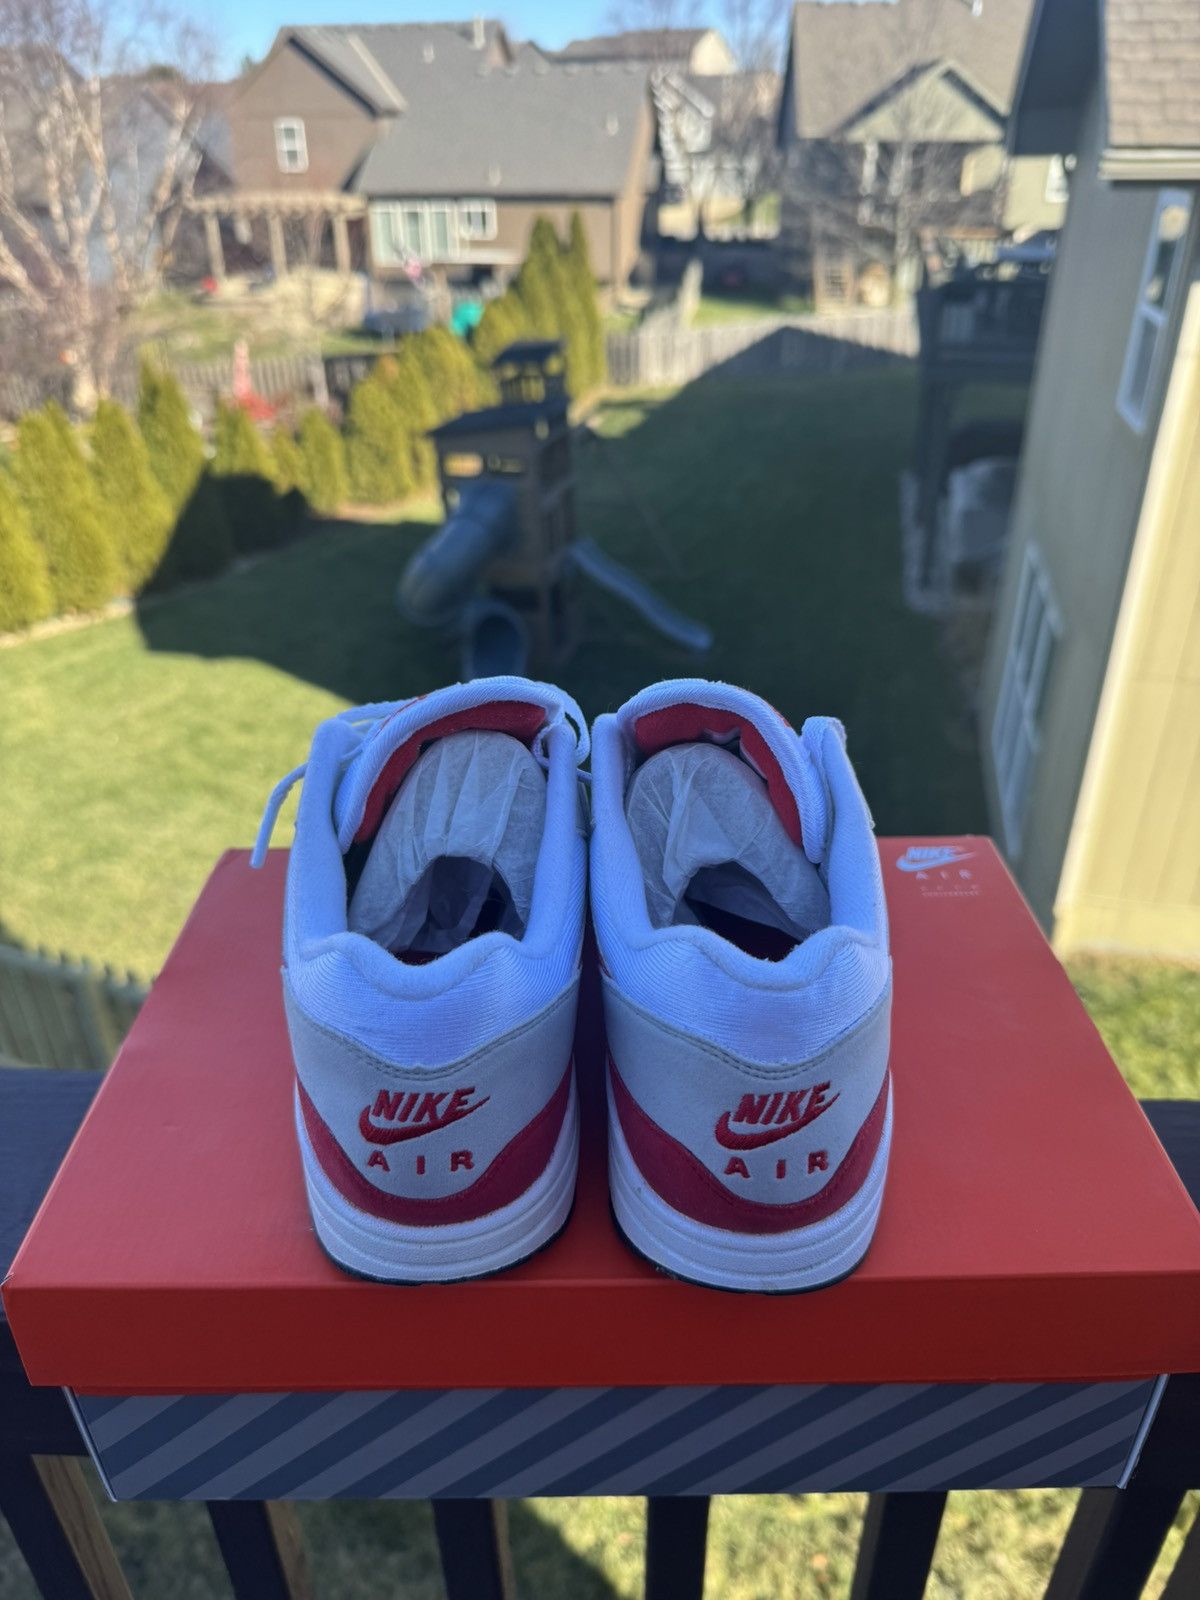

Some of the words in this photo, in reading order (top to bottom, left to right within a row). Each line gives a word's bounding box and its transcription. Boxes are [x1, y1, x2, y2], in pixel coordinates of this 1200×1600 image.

[371, 1086, 476, 1122] NIKE
[731, 1080, 832, 1125] NIKE
[367, 1150, 475, 1175] AIR
[723, 1149, 829, 1179] AIR
